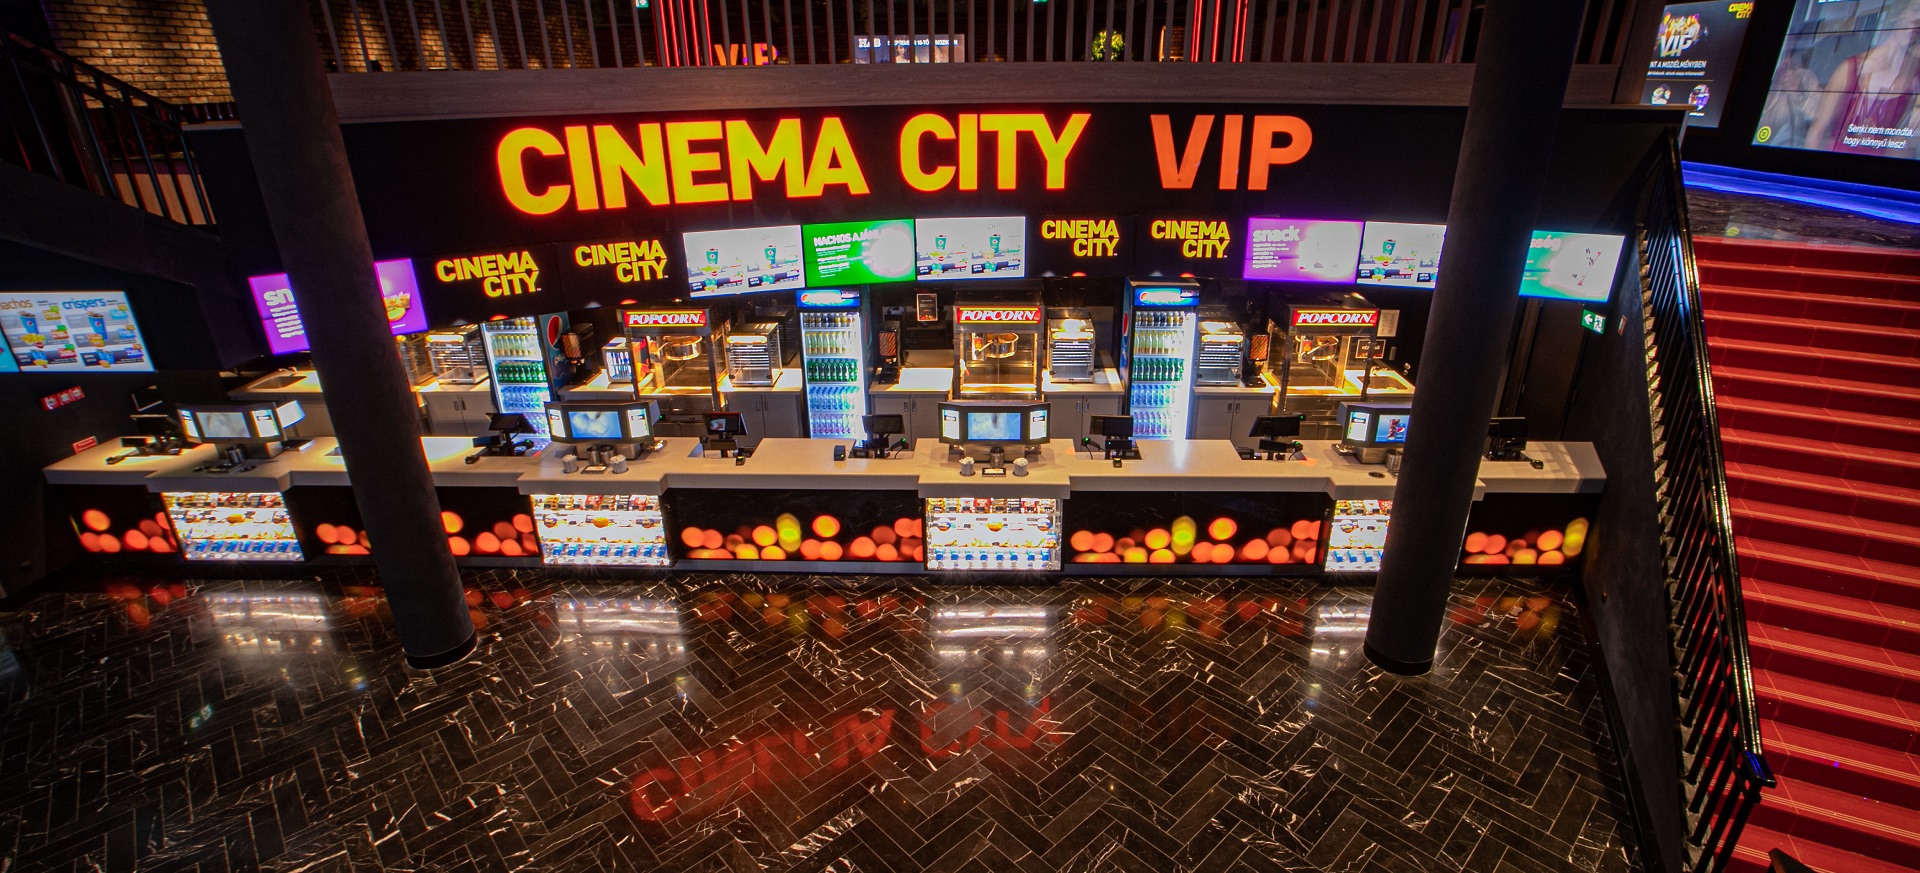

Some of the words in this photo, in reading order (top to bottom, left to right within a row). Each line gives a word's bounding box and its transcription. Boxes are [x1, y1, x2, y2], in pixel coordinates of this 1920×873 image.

[714, 43, 778, 66] VIP
[1660, 35, 1693, 58] VIP
[1847, 123, 1869, 134] Senki
[1868, 126, 1884, 135] nem
[1843, 136, 1861, 147] hogy
[496, 115, 871, 216] CINEMA
[898, 112, 1092, 194] CITY
[1151, 114, 1314, 191] VIP
[813, 232, 852, 246] NACHOS
[1041, 219, 1119, 240] CINEMA
[1151, 220, 1230, 240] CINEMA
[1252, 225, 1301, 242] snack
[575, 239, 668, 267] CINEMA
[1073, 238, 1119, 257] CITY
[1182, 239, 1230, 259] CITY
[436, 250, 540, 283] CINEMA
[615, 259, 668, 283] CITY
[482, 271, 540, 298] CITY
[61, 298, 107, 311] crispers
[629, 313, 701, 324] POPCORN
[960, 310, 1037, 321] POPCORN
[1297, 313, 1374, 324] POPCORN
